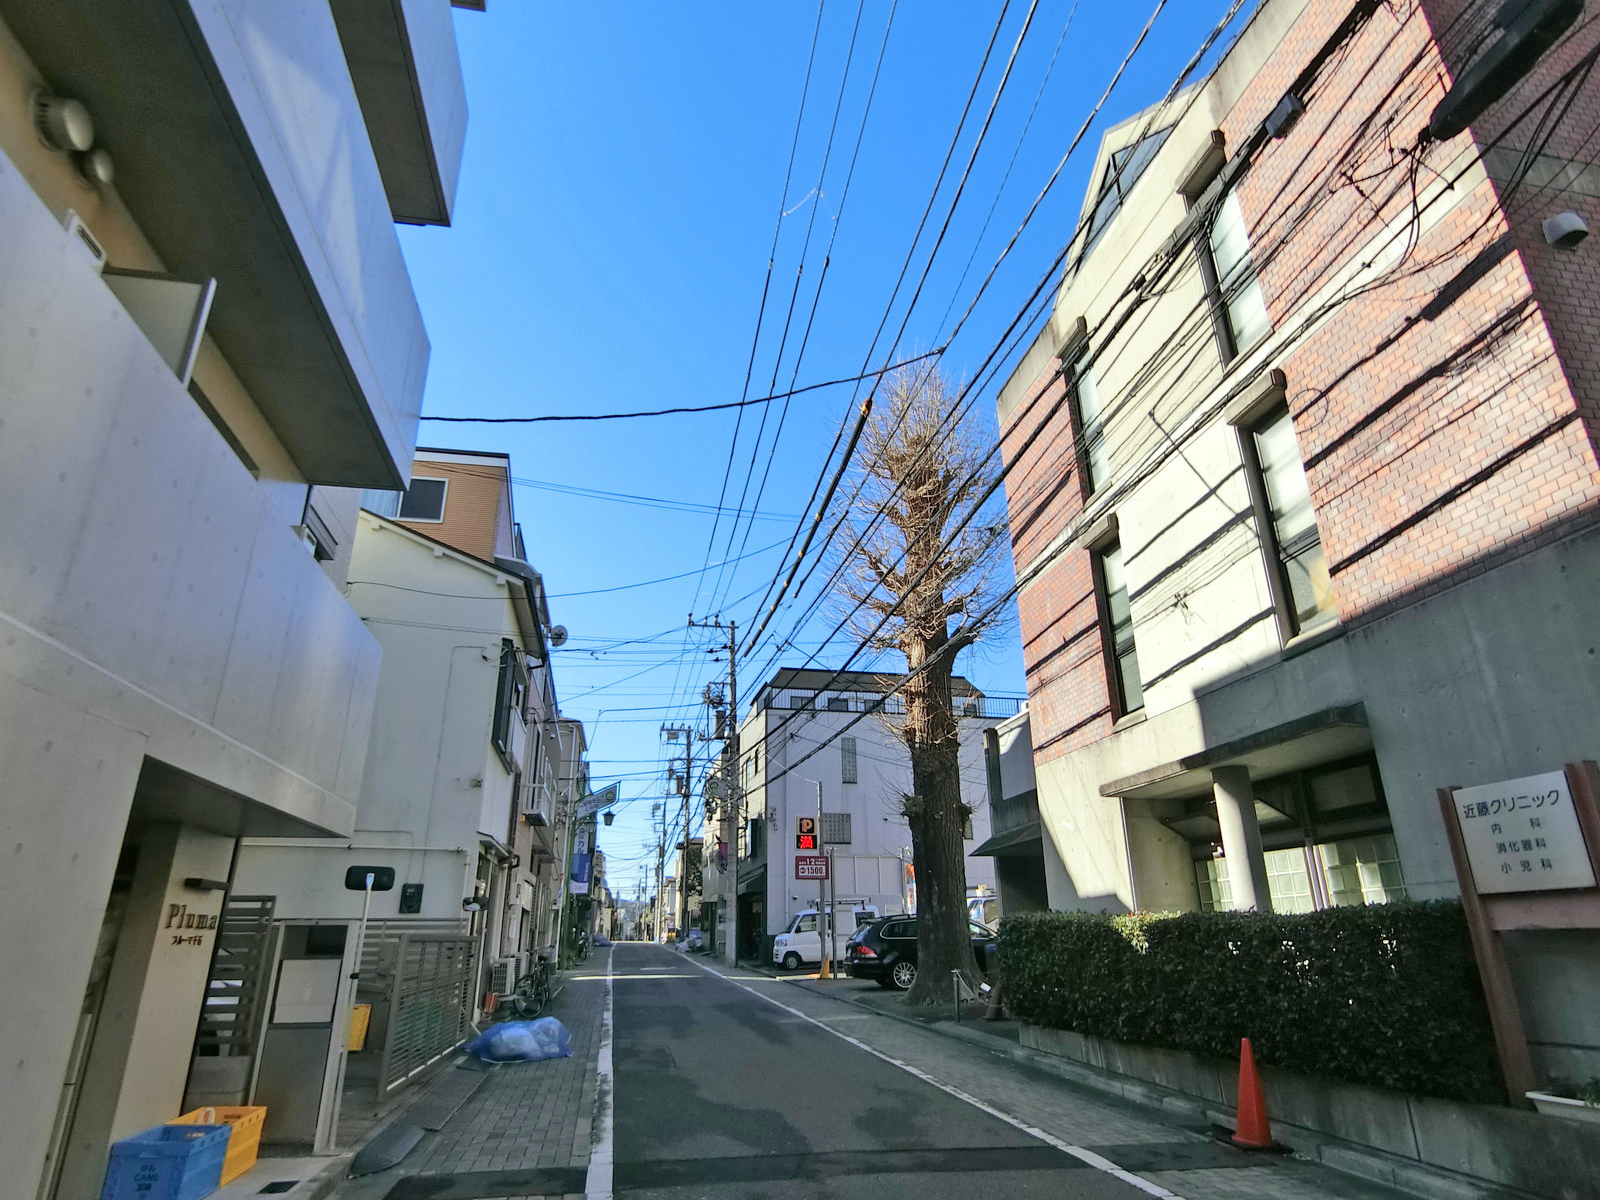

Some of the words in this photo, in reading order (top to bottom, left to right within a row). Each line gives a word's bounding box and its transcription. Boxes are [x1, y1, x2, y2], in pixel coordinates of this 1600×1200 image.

[1463, 789, 1559, 819] 近藤クリニック
[800, 835, 813, 849] 満
[1496, 838, 1547, 854] 消化器科
[807, 866, 823, 875] 1500
[1502, 858, 1552, 874] 小児科
[164, 903, 218, 930] Pluma
